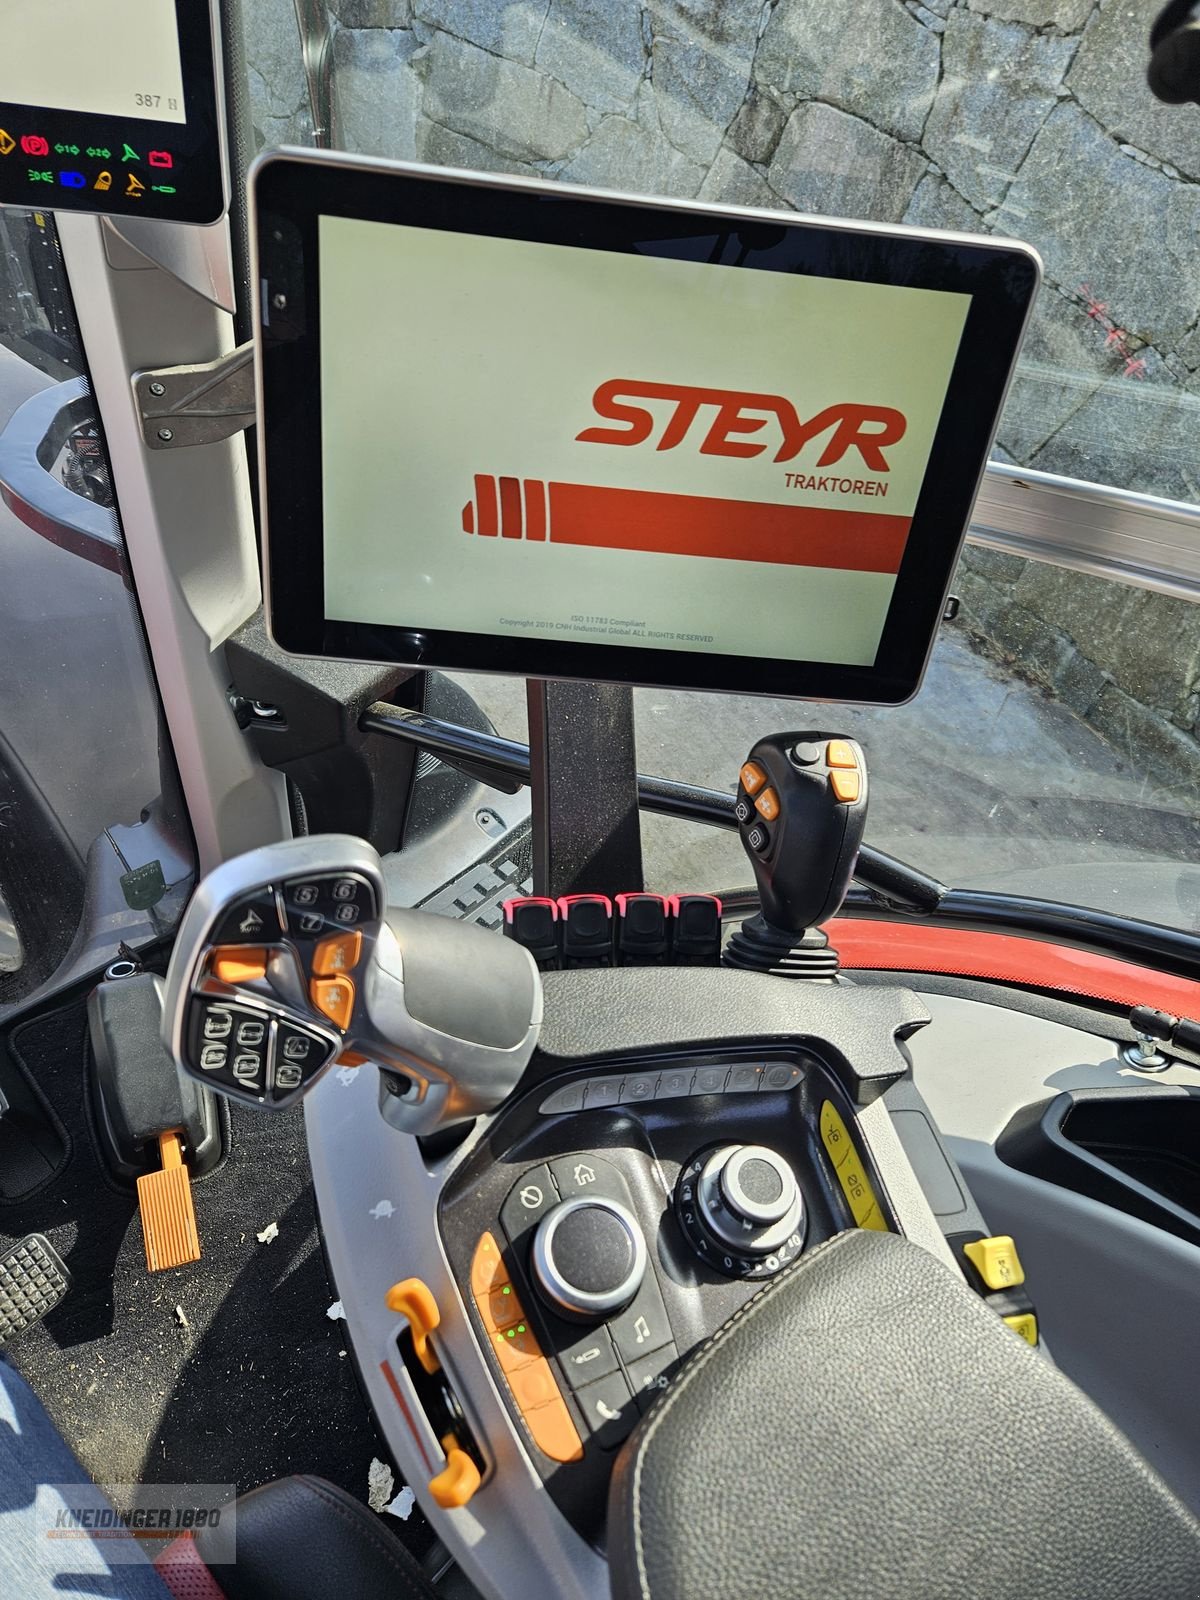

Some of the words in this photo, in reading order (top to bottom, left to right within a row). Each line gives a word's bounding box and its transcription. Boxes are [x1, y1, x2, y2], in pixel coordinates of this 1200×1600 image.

[134, 92, 161, 108] 387
[575, 378, 907, 472] STEYR
[784, 473, 888, 498] TRAKTOREN
[499, 618, 534, 628] Copyright
[536, 621, 554, 629] 2019
[573, 624, 607, 633] Industrial
[608, 627, 631, 636] Global
[632, 629, 646, 637] ALL
[647, 630, 674, 640] RIGHTS
[676, 633, 714, 643] RESERVED
[609, 618, 646, 628] Compliant
[300, 887, 312, 900] 5
[339, 884, 351, 897] 6
[306, 913, 320, 926] 7
[342, 906, 354, 919] 8
[636, 1083, 645, 1094] 2
[672, 1078, 679, 1089] 3
[683, 1185, 692, 1194] 3
[685, 1214, 694, 1224] 2
[700, 1240, 708, 1250] 1
[787, 1234, 801, 1248] 10
[724, 1257, 733, 1268] 0
